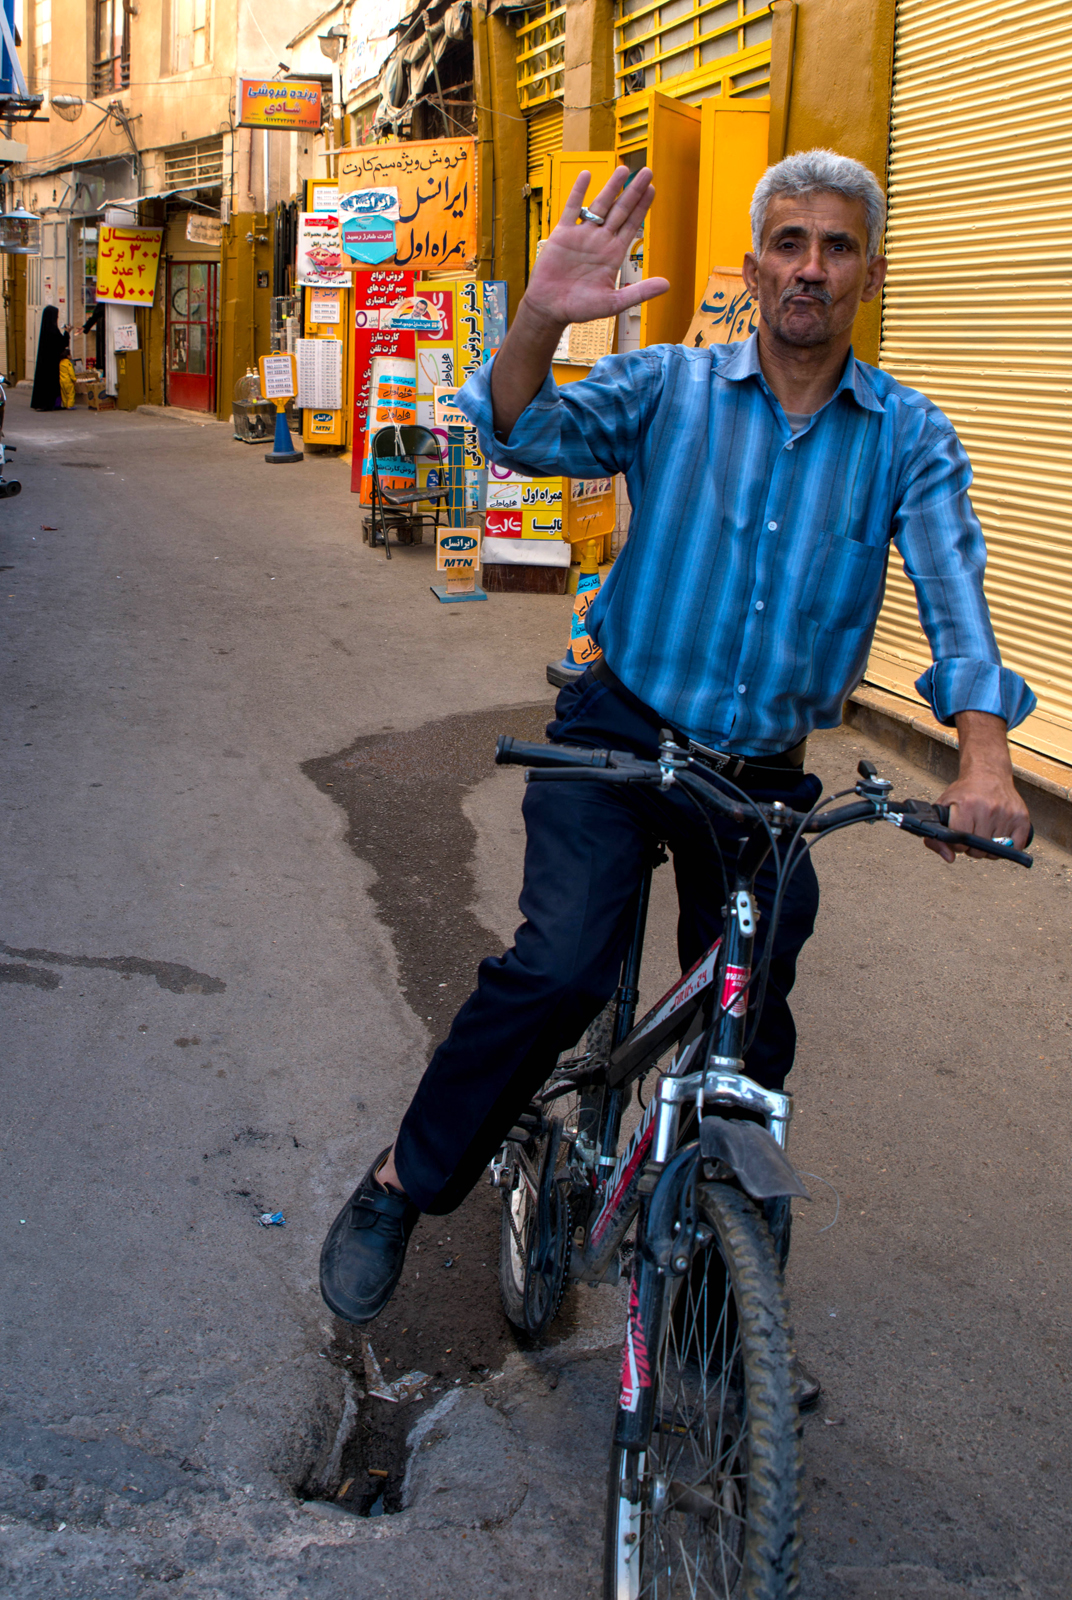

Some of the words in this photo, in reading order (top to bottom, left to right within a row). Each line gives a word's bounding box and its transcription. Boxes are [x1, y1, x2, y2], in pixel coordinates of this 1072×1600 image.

[247, 84, 287, 99] فروشی
[289, 88, 318, 105] پرنده
[264, 101, 301, 115] شادی
[397, 152, 420, 174] ویژه
[420, 147, 467, 170] فروش
[342, 156, 379, 177] کارت
[373, 163, 396, 183] سیم
[347, 195, 390, 212] ایرانسل
[398, 176, 468, 223] ایرانسل
[102, 228, 161, 243] دستمال
[346, 233, 362, 241] رسید
[101, 246, 125, 262] برگ
[129, 243, 158, 261] ۳۰۰
[394, 228, 430, 266] اول
[431, 230, 466, 266] همراه
[112, 266, 134, 276] عدد
[137, 264, 146, 278] ۴
[370, 271, 386, 282] انواع
[386, 271, 404, 282] فروش
[96, 284, 110, 296] ت
[113, 278, 154, 299] ۵۰۰۰
[367, 283, 379, 294] های
[379, 283, 395, 294] کارت
[395, 285, 407, 293] سیم
[460, 283, 481, 315] دفتر
[701, 289, 749, 325] کارت
[370, 331, 383, 343] شارژ
[384, 332, 400, 343] کارت
[460, 316, 481, 359] فروش
[369, 344, 382, 354] تلفن
[382, 344, 398, 355] کارت
[315, 413, 332, 421] ایرانسل
[442, 414, 470, 423] MTN
[522, 487, 539, 506] اول
[486, 516, 521, 533] تالیا
[444, 538, 474, 550] ایرانسل
[443, 558, 473, 567] MTN
